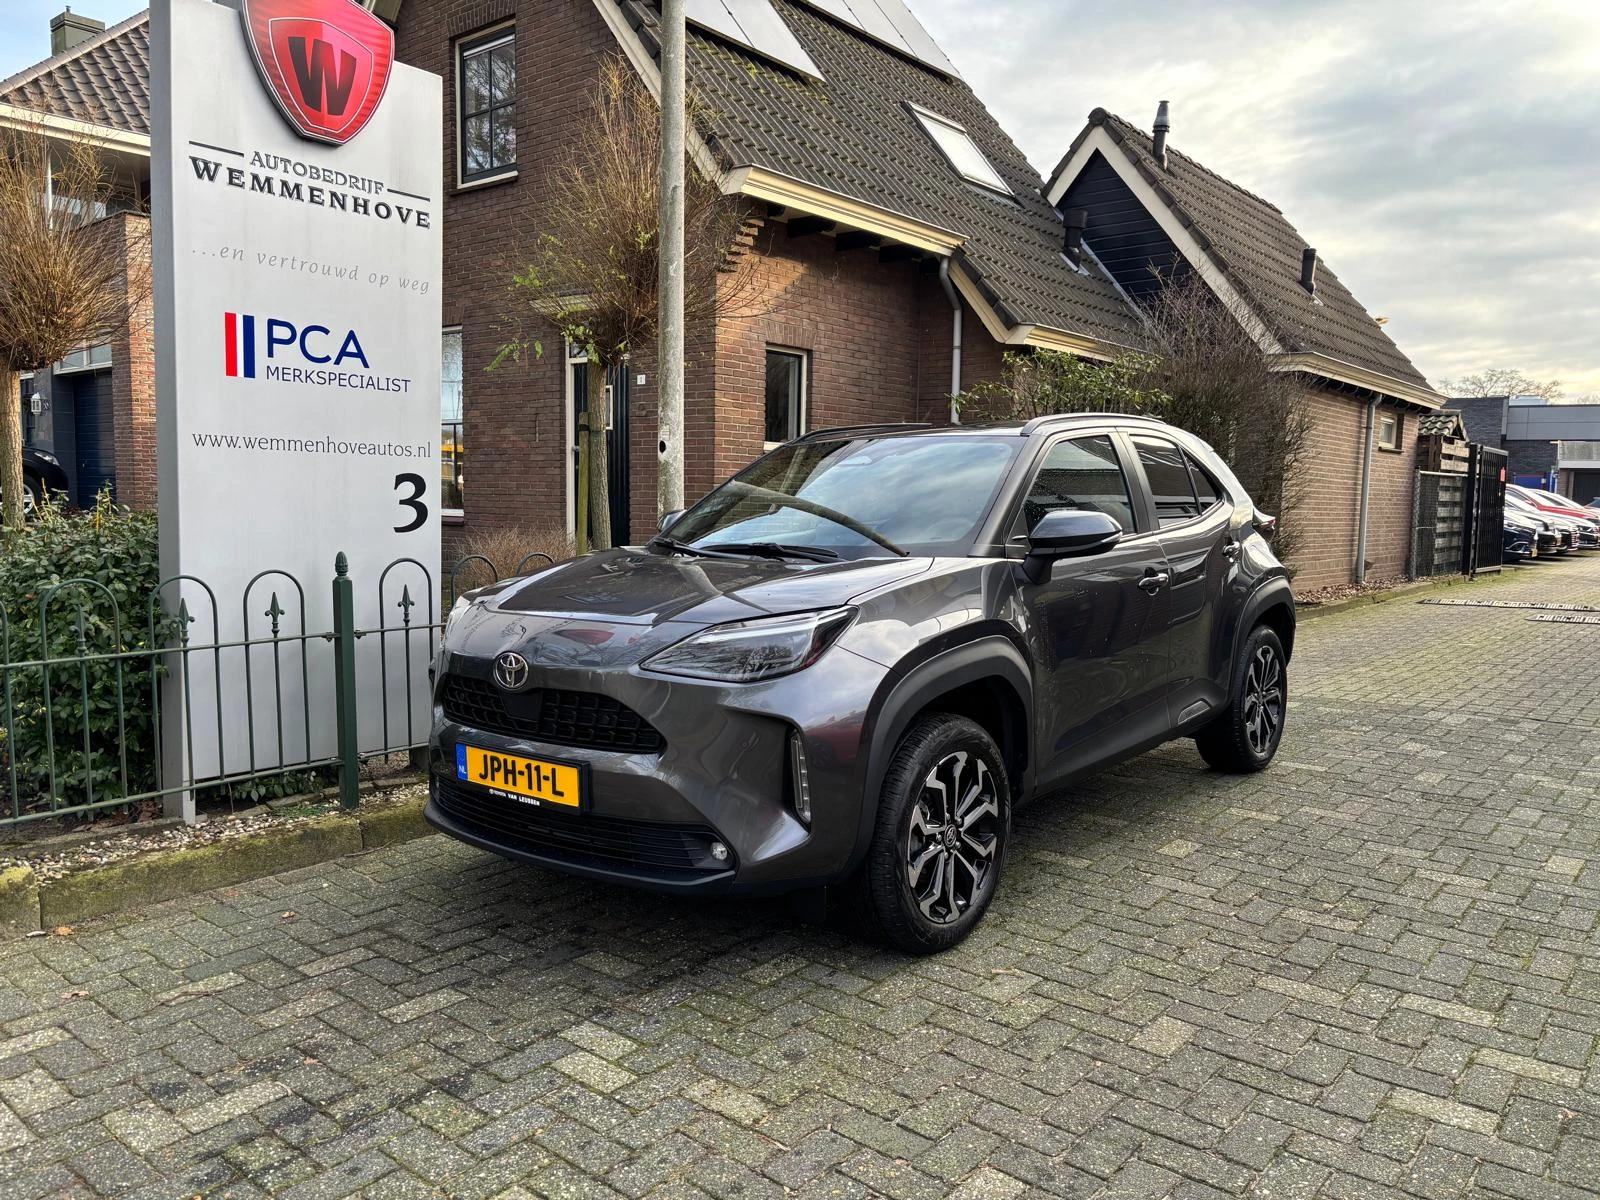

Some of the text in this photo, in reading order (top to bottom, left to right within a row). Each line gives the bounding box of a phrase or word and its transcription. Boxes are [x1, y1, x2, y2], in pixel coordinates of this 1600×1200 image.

[288, 36, 357, 116] W
[188, 155, 431, 229] WEMMENHOVE
[250, 150, 384, 195] AUTOBEDRIJF
[257, 252, 359, 281] vertrouwd
[368, 271, 389, 287] op
[399, 278, 430, 294] weg
[267, 318, 370, 369] PCA
[266, 365, 411, 393] MERKSPECIALIST
[192, 433, 431, 458] www.wemmenhoveautos.nl
[393, 472, 429, 534] 3
[479, 754, 564, 797] JPH-11-L
